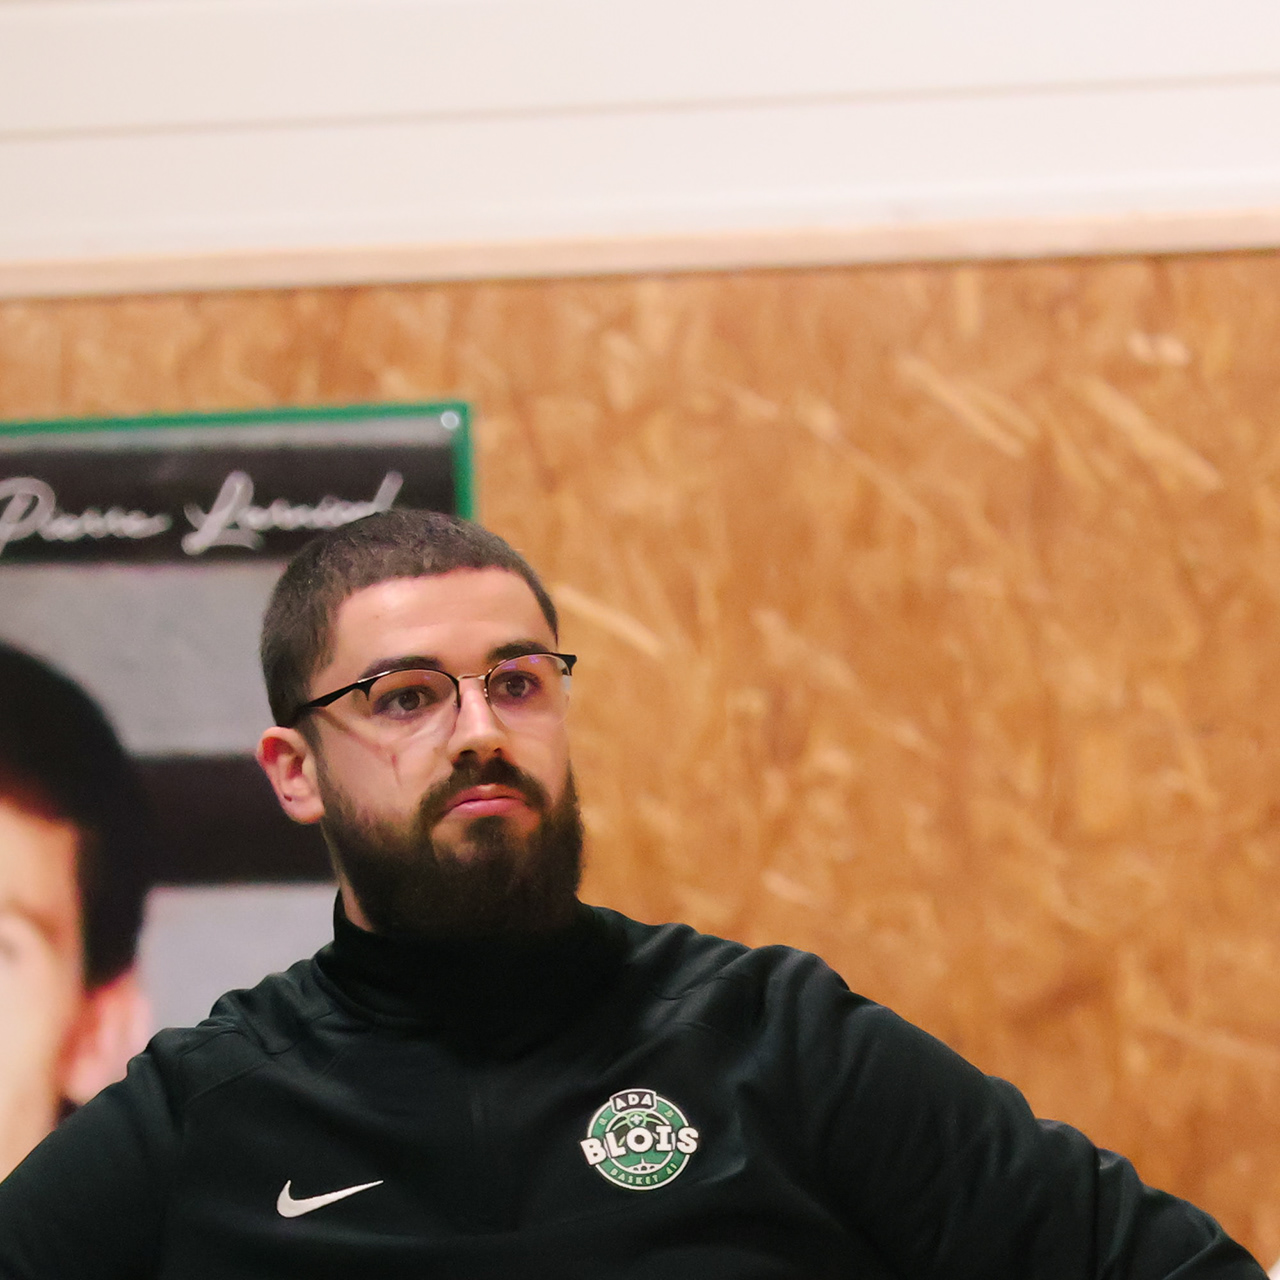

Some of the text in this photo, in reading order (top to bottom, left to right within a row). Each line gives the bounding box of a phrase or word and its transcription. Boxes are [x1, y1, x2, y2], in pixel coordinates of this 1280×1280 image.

[615, 1093, 653, 1110] ADA
[580, 1125, 700, 1166] BLOIS
[610, 1168, 659, 1185] BASKET
